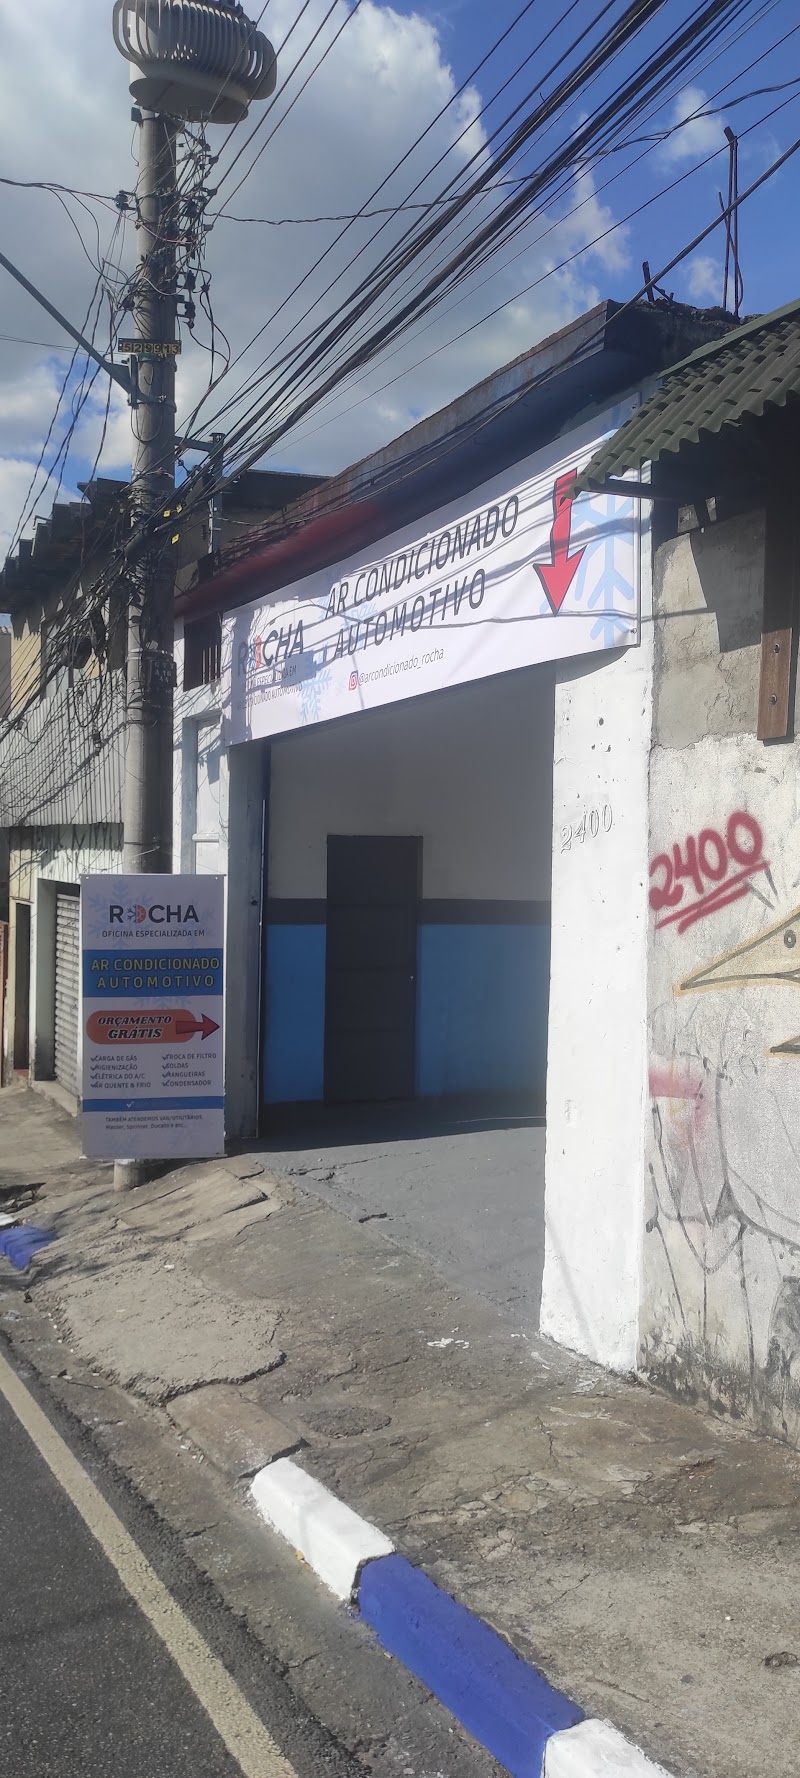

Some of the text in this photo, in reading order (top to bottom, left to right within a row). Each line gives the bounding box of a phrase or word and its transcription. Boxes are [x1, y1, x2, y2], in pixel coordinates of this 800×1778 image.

[325, 495, 519, 620] AR CONDICIONADO
[333, 568, 486, 659] AUTOMOTIVO
[237, 619, 304, 677] ROCHA
[357, 647, 445, 687] @arcondicionado_rocha
[560, 803, 614, 855] 2400
[649, 809, 764, 911] 2400
[108, 904, 200, 924] ROCHA
[101, 929, 205, 938] OFICINA ESPECIALIZADA EM
[91, 957, 220, 971] AR CONDICIONADO
[97, 974, 214, 989] AUTOMOTIVO
[98, 1015, 172, 1026] ORÇAMENTO
[107, 1025, 163, 1039] GRÁTIS
[125, 1054, 138, 1062] GÁS
[95, 1072, 123, 1080] ELÉTRICA
[166, 1079, 212, 1087] CONDENSADOR
